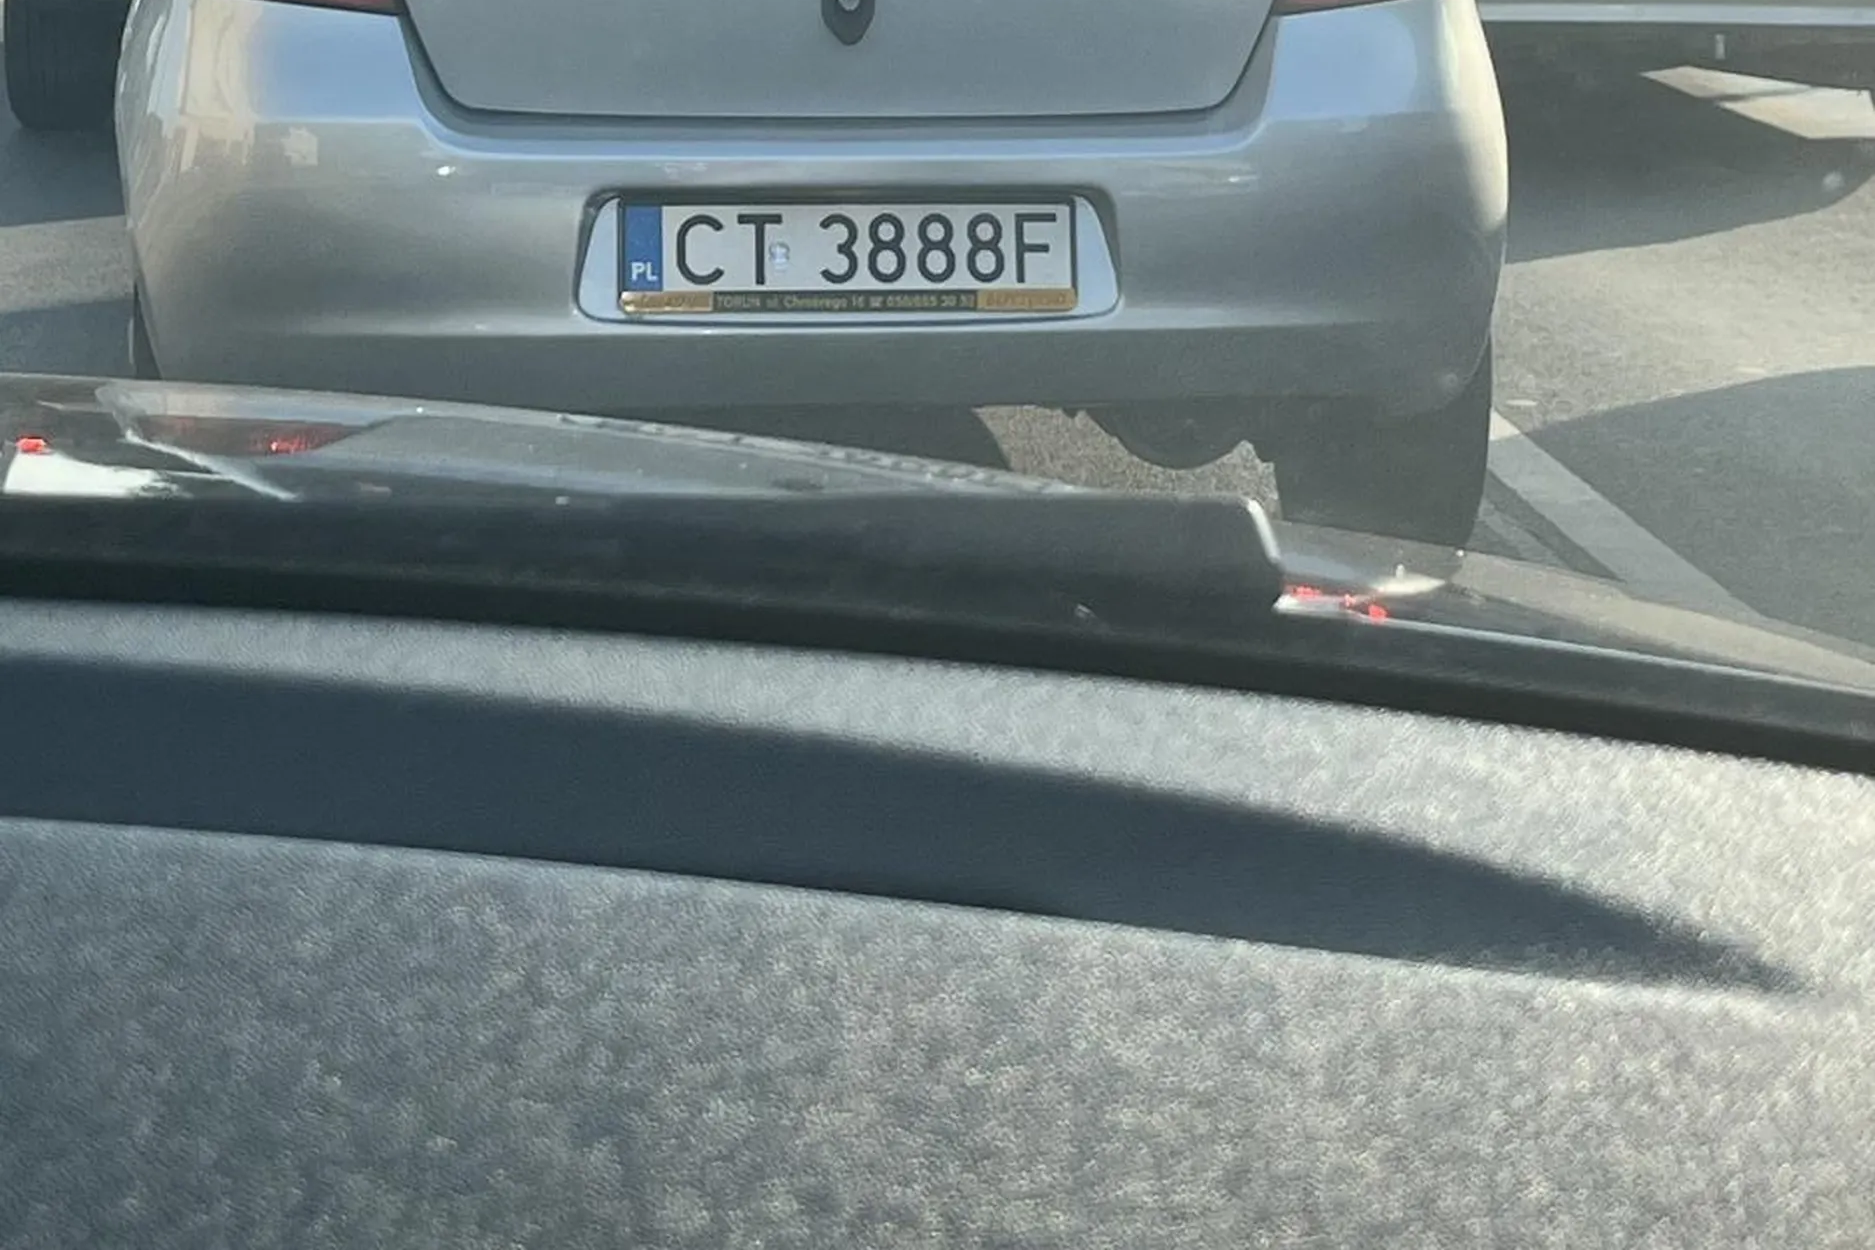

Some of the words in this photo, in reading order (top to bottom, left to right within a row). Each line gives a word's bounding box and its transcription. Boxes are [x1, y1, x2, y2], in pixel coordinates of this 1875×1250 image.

[630, 261, 659, 281] PL
[676, 213, 783, 285] CT
[818, 212, 1058, 284] 3888F
